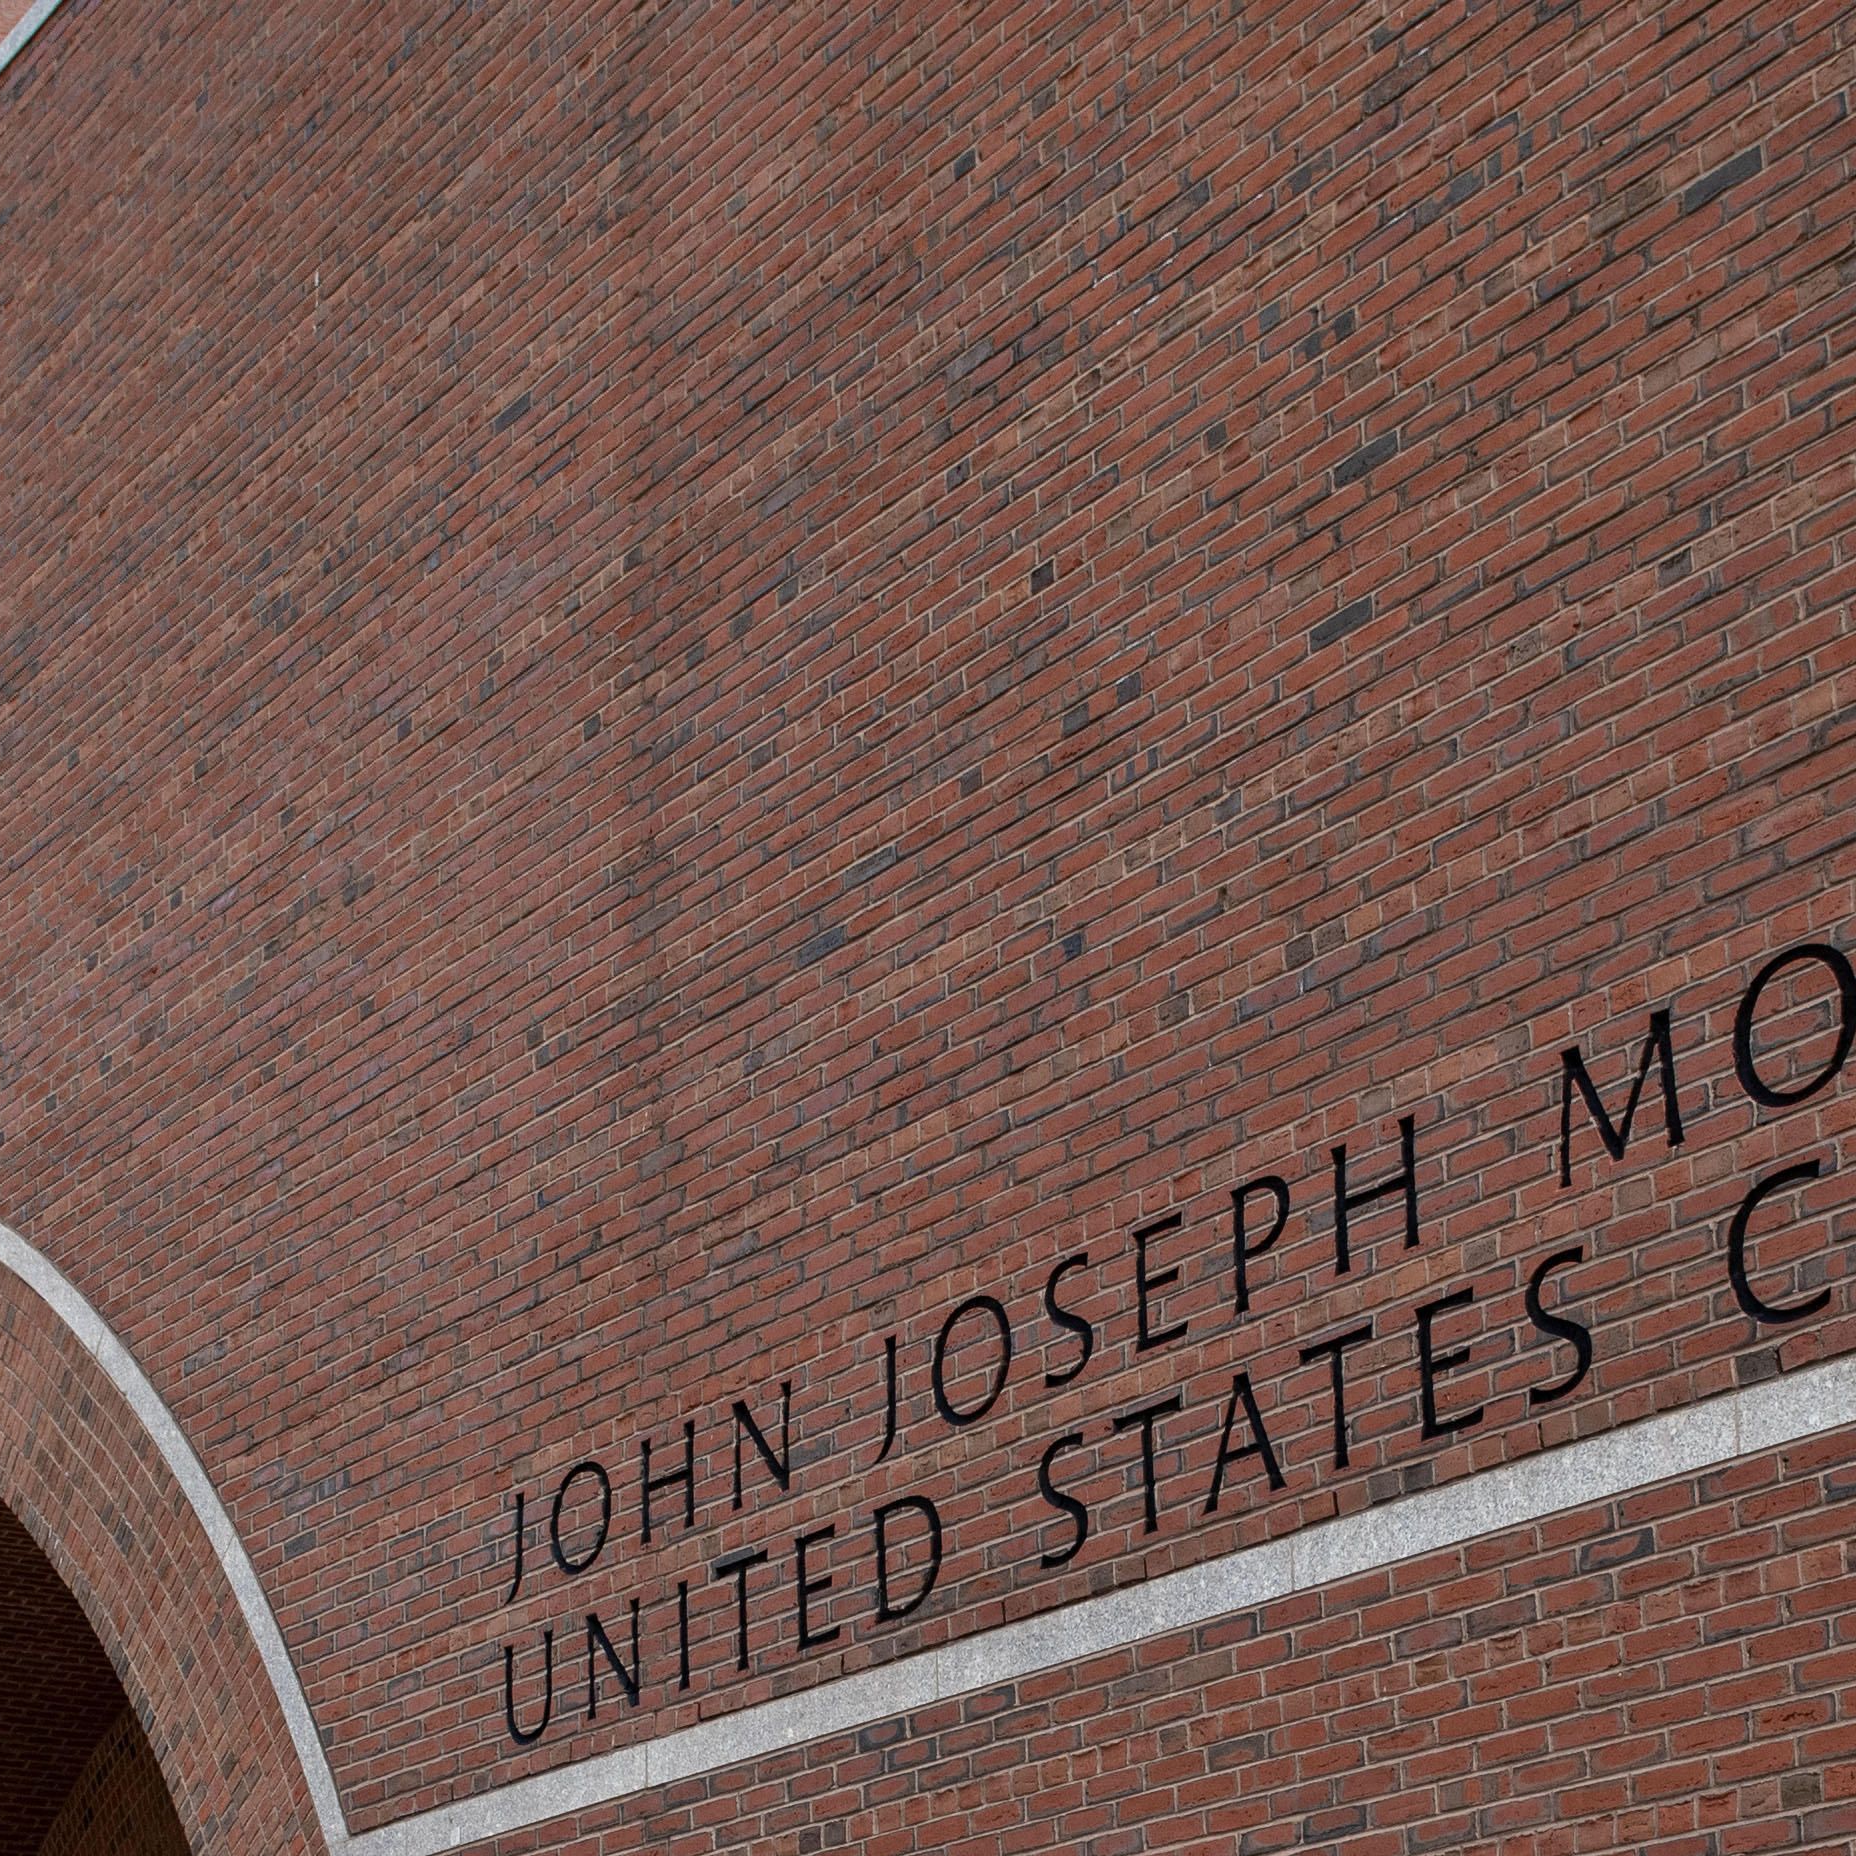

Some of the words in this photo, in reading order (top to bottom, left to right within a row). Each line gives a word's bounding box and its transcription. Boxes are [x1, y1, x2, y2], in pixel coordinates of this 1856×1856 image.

[503, 1494, 944, 1748] UNITED
[1040, 1245, 1593, 1572] STATES
[505, 1380, 792, 1605] JOHN
[874, 1114, 1421, 1464] JOSEPH
